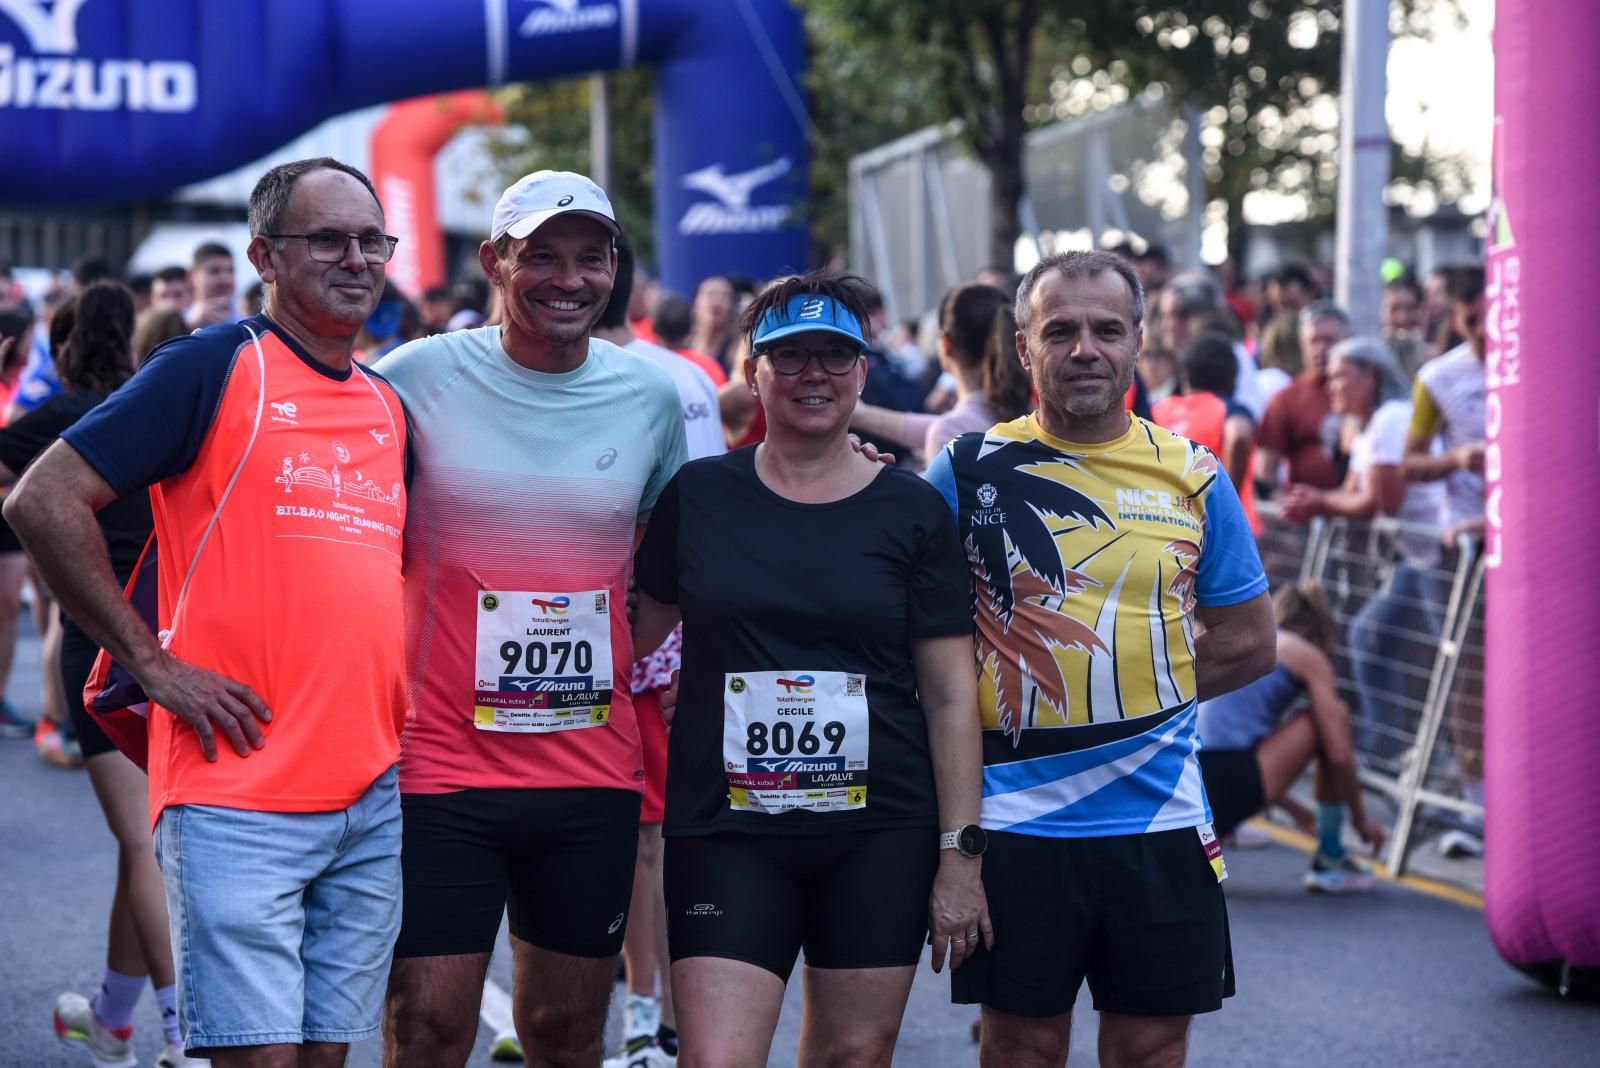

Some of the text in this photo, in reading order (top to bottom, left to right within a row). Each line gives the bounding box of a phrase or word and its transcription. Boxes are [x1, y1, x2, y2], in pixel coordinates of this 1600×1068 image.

[1115, 487, 1173, 510] NICE
[275, 505, 325, 519] BILBAO
[326, 511, 351, 524] NIGHT
[971, 512, 1007, 526] NICE
[1118, 512, 1200, 533] INTERNATIONAL
[526, 628, 571, 636] LAURENT
[500, 640, 592, 675] 9070
[536, 680, 585, 691] MIZUNO
[562, 693, 573, 702] LA
[596, 711, 604, 720] 6
[777, 708, 814, 716] CECILE
[746, 721, 846, 756] 8069
[784, 761, 837, 772] MIZUNO
[812, 774, 824, 783] LA
[854, 792, 861, 802] 6
